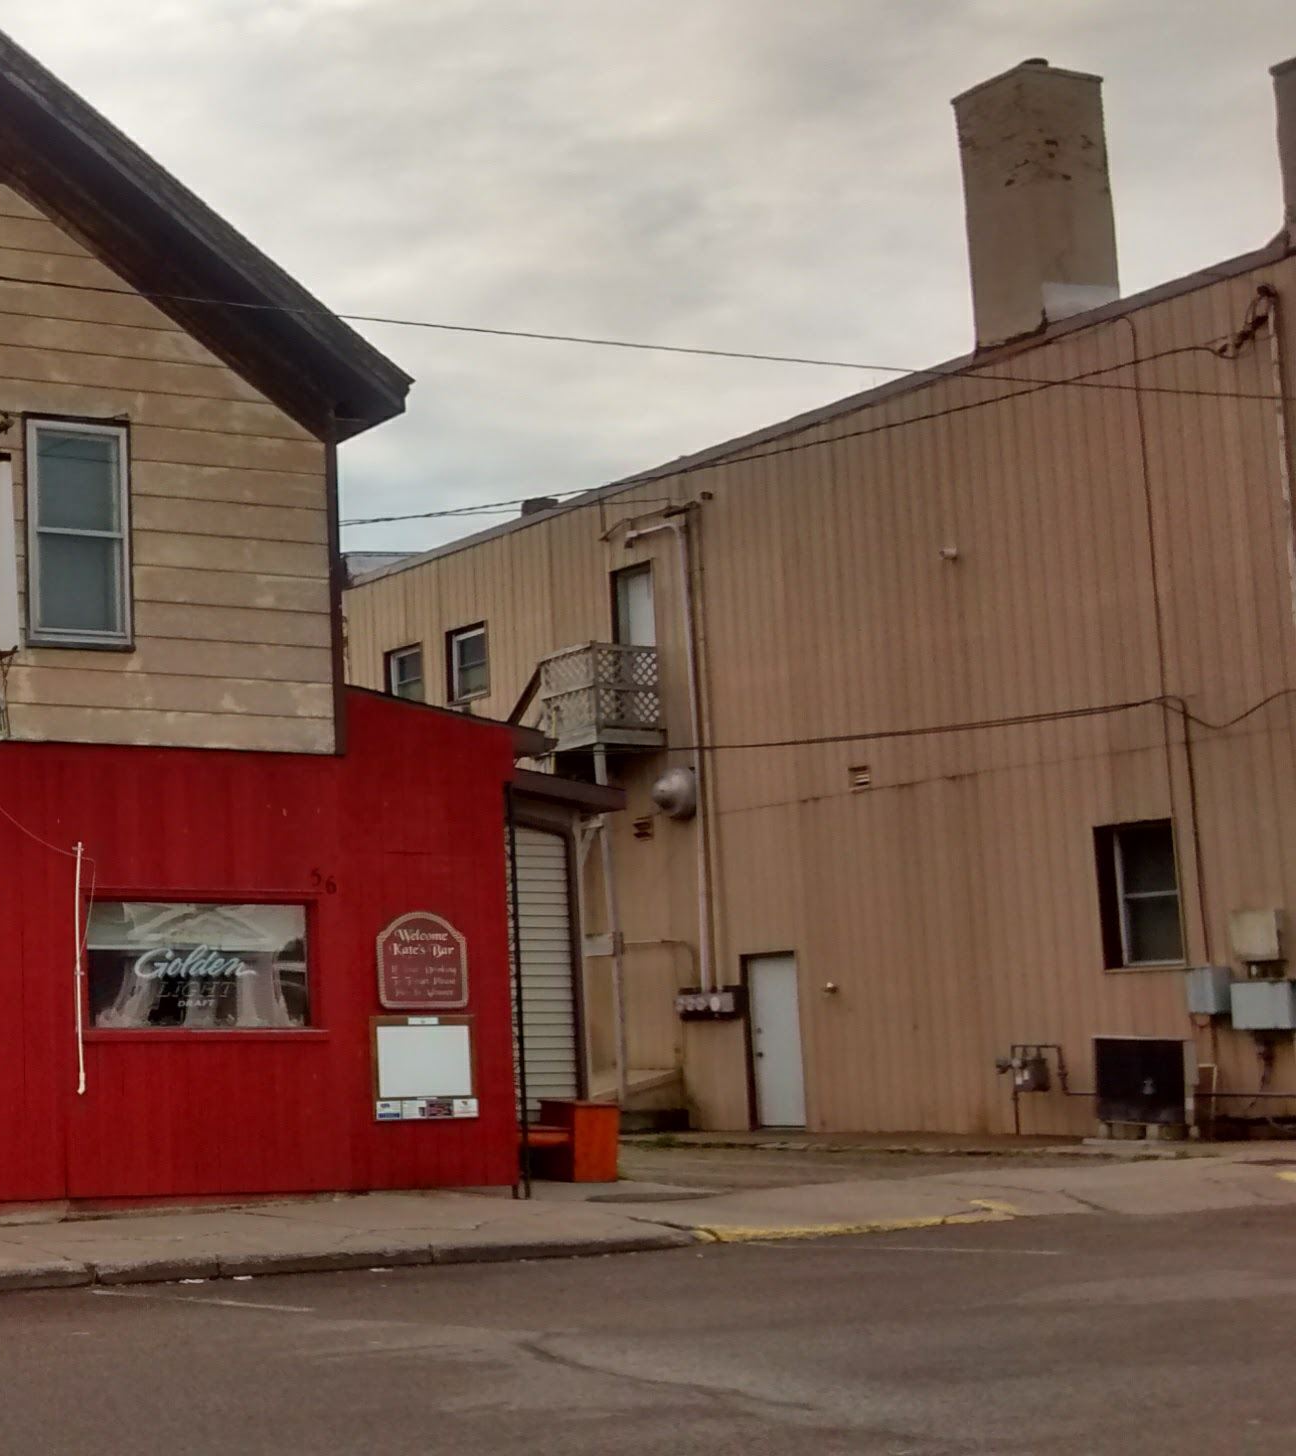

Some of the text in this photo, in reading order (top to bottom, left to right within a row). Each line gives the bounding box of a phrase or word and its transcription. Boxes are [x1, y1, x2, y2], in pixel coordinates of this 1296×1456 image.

[394, 929, 449, 942] Welcome
[431, 944, 455, 958] Bar
[134, 944, 258, 979] Golden
